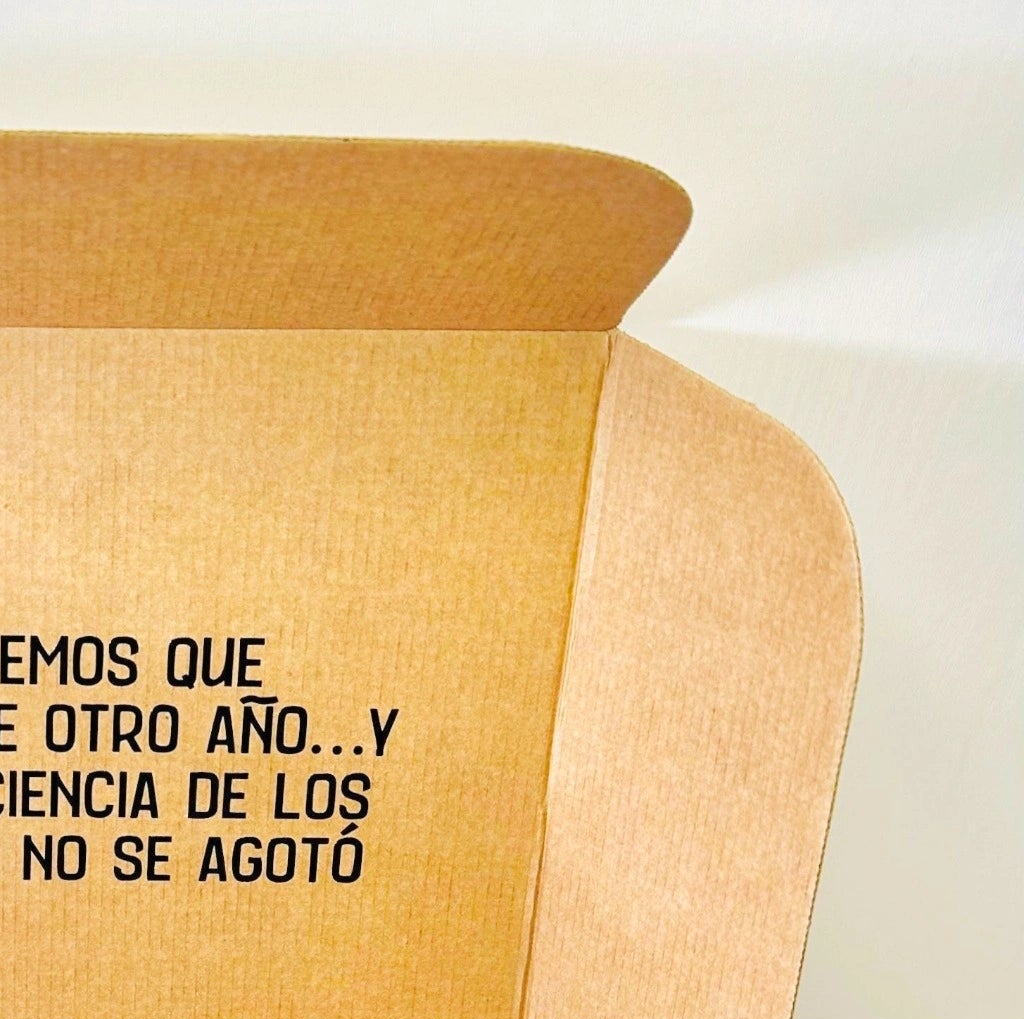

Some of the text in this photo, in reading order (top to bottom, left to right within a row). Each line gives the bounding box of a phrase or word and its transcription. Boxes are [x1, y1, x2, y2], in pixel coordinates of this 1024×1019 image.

[167, 636, 265, 689] QUE
[45, 704, 178, 753] OTRO
[188, 772, 246, 819] DE
[274, 772, 371, 820] LOS
[24, 835, 87, 880] NO
[113, 835, 173, 881] SE
[199, 825, 364, 883] AGOTÓ
